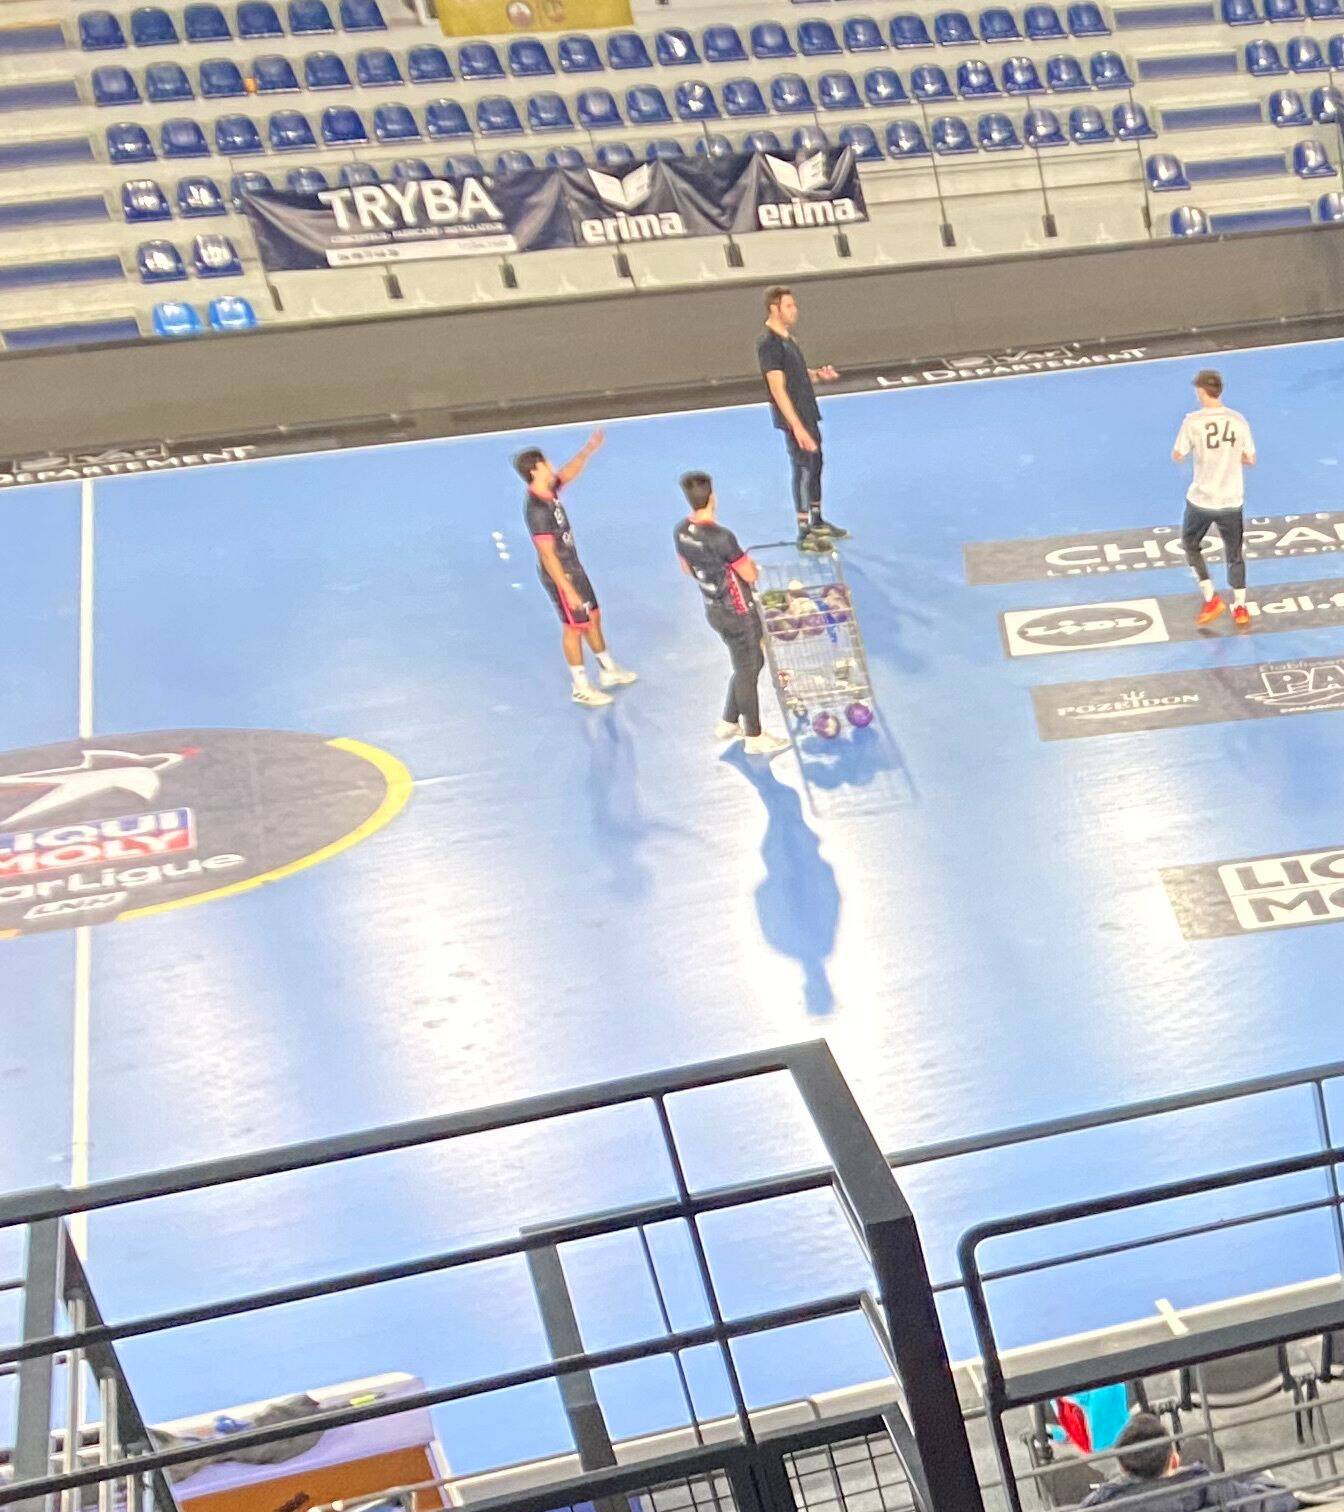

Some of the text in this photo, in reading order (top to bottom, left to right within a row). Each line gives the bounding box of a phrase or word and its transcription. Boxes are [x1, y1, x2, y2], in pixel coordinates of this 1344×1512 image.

[317, 176, 504, 232] TRYBA
[757, 197, 857, 228] erima
[580, 210, 685, 244] erima
[1205, 420, 1237, 450] 24
[0, 852, 247, 903] arLigue
